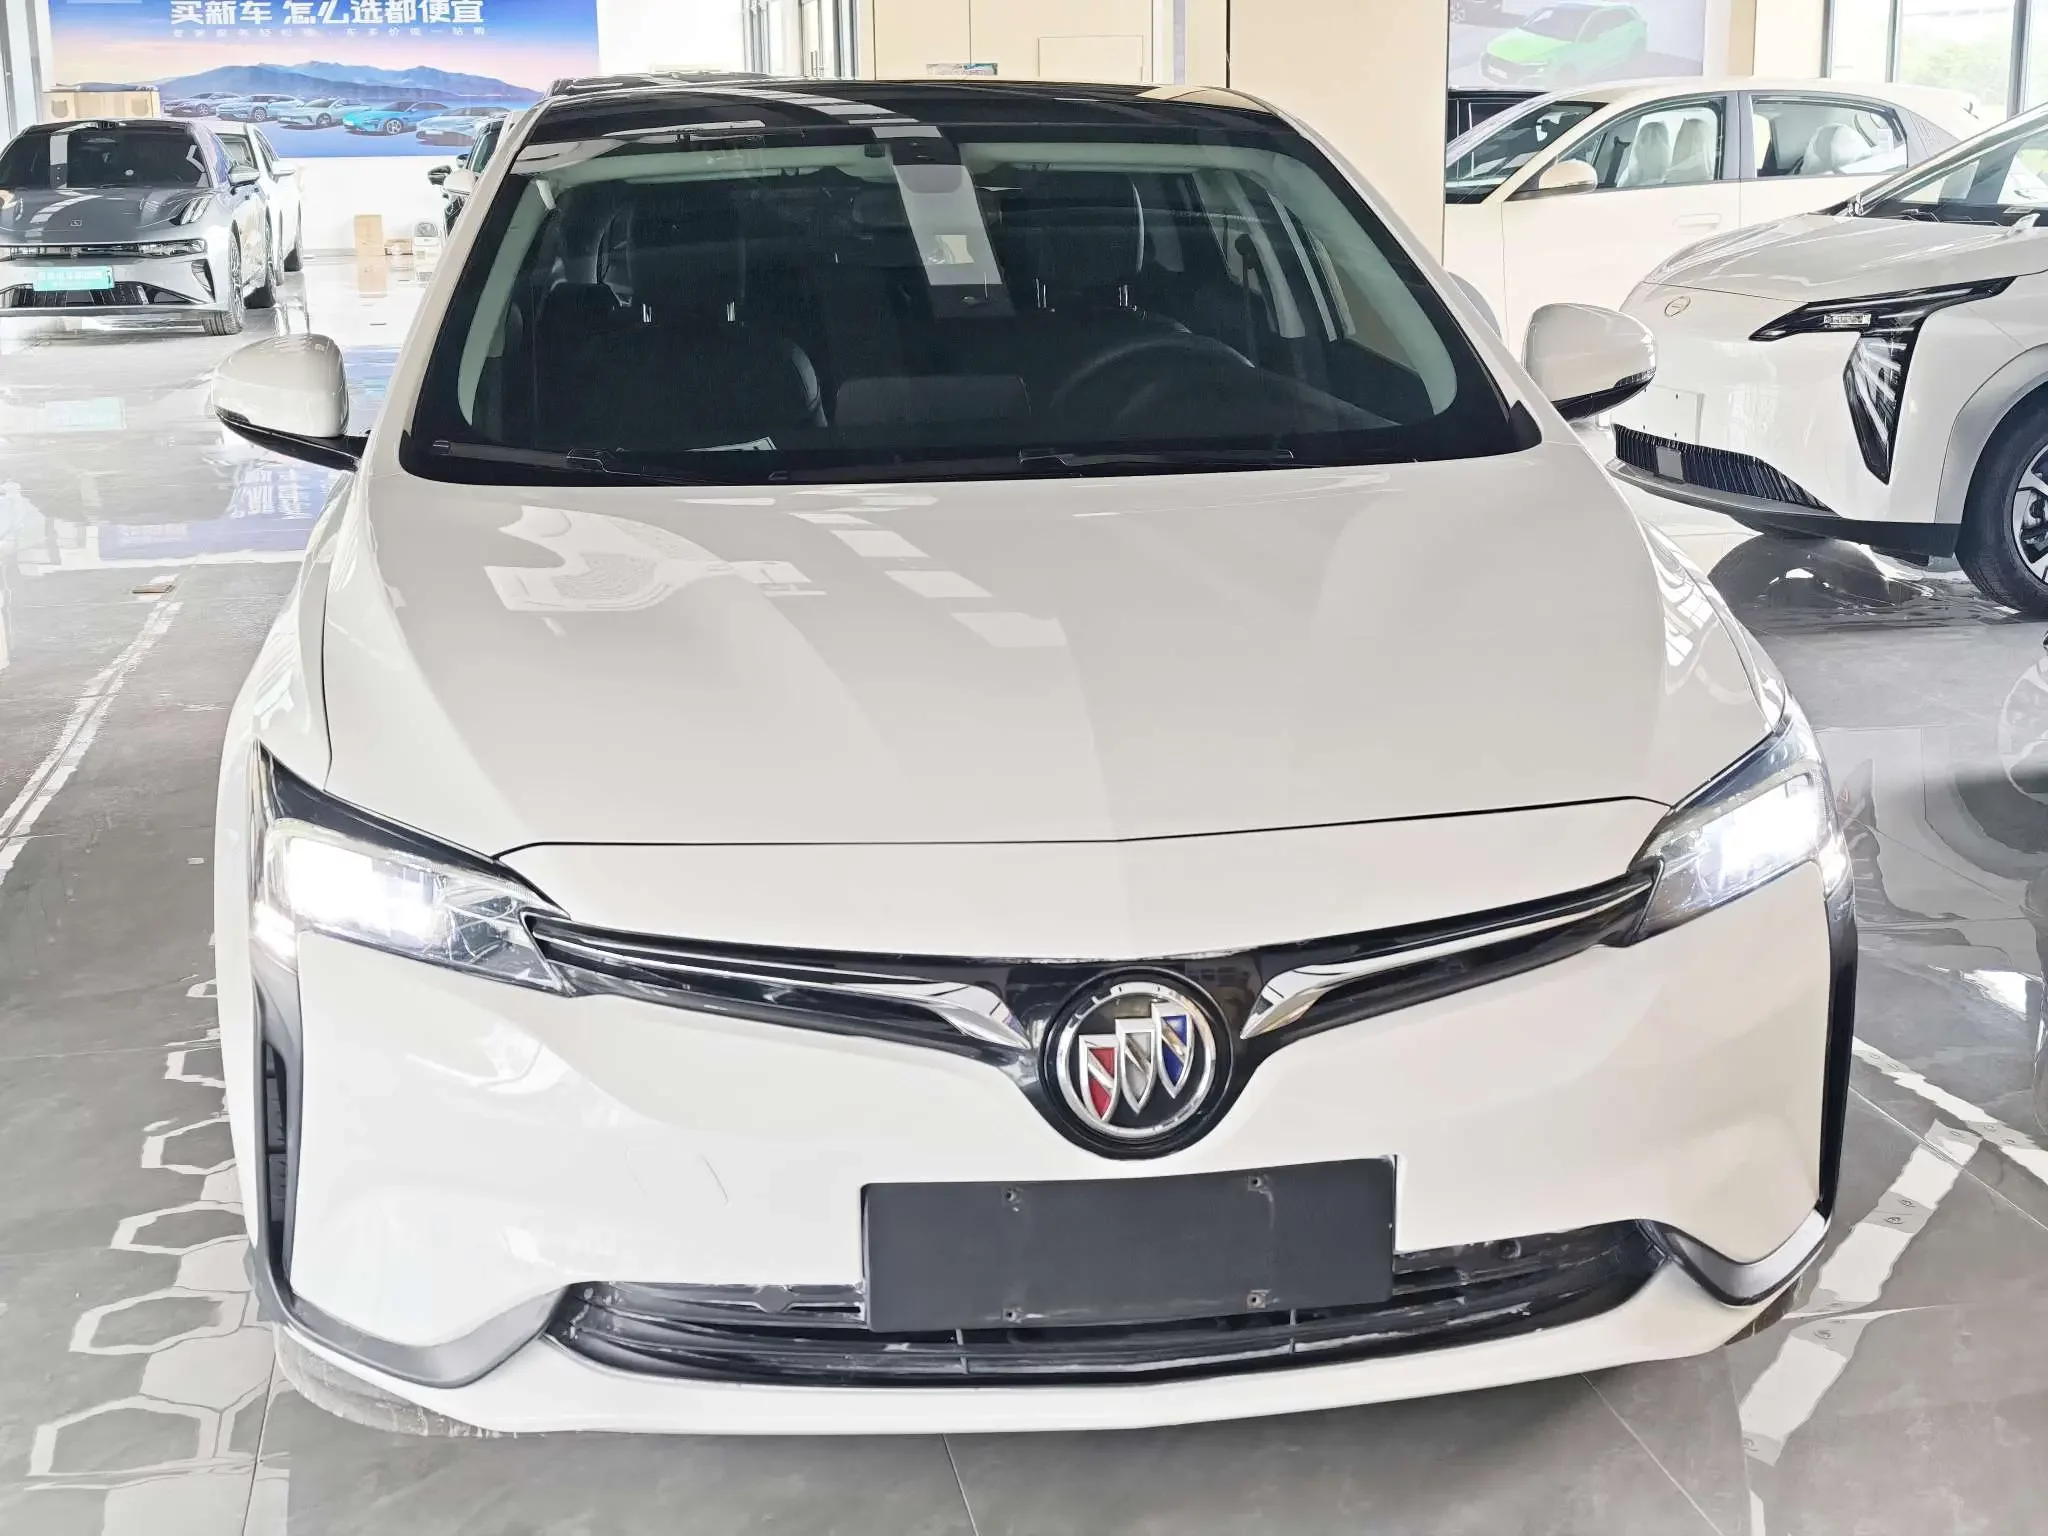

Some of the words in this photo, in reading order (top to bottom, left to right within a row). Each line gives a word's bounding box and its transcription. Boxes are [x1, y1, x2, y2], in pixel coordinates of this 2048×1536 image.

[171, 0, 272, 24] 买新车
[283, 0, 484, 24] 怎么选都便宜
